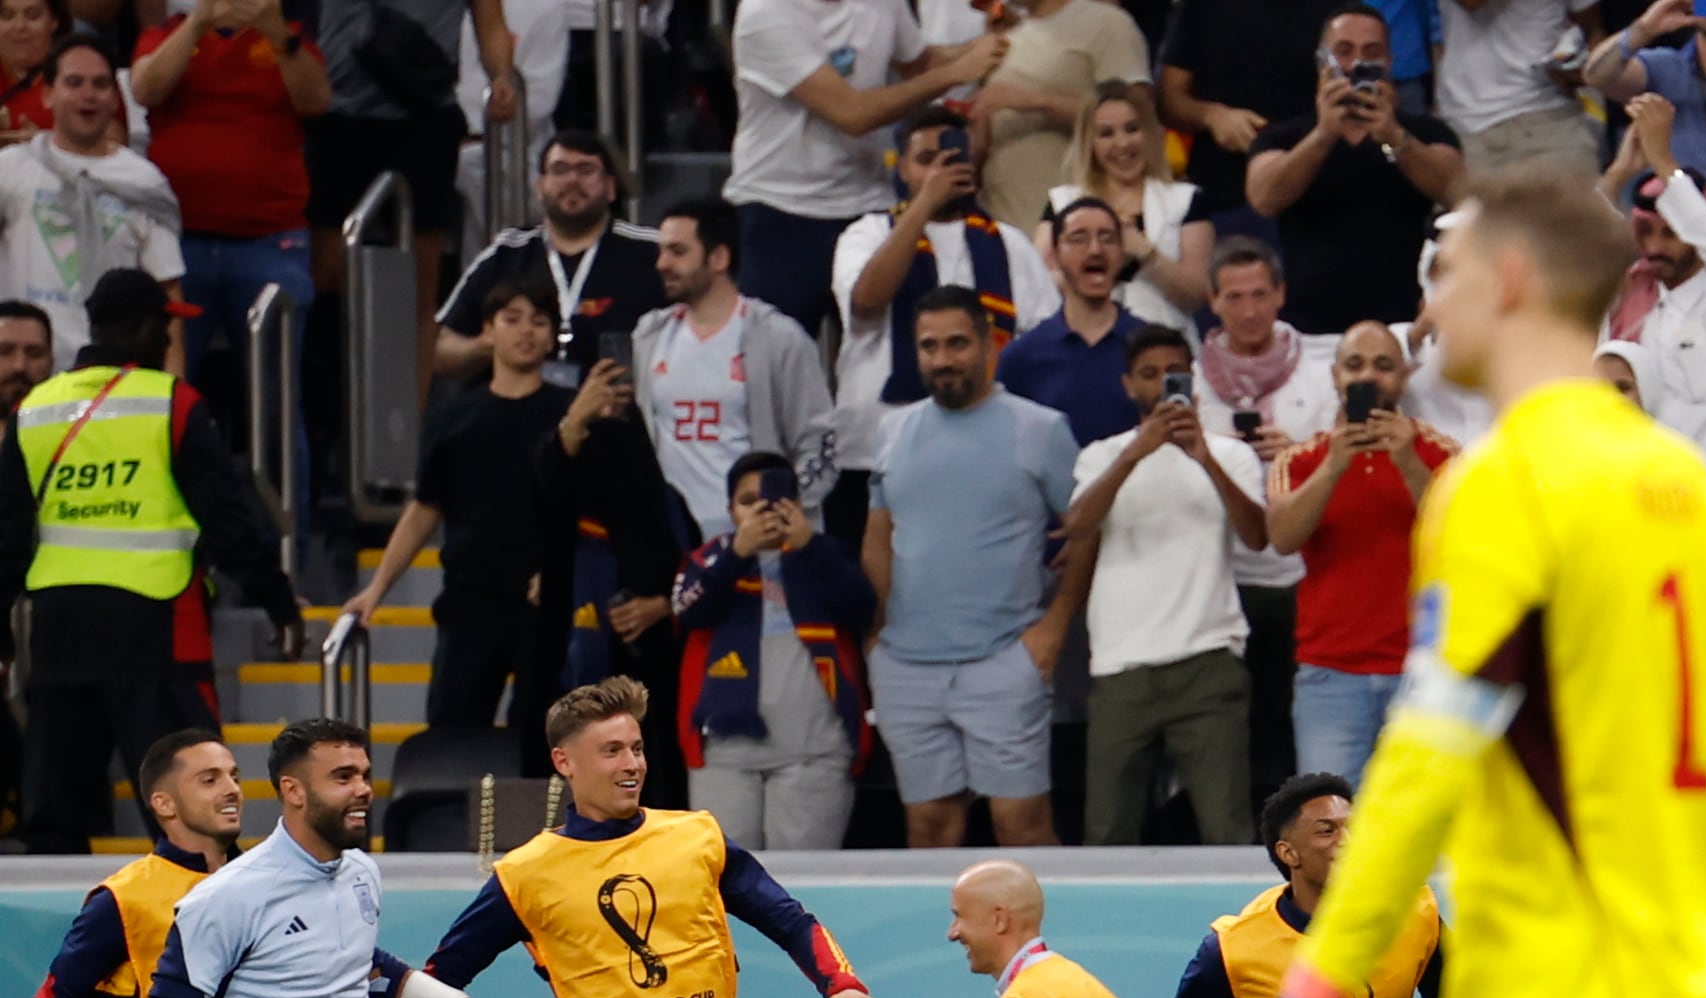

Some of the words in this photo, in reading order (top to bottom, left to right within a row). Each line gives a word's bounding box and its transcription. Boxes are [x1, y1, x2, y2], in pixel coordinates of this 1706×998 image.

[674, 400, 721, 441] 22
[56, 460, 141, 490] 2917
[57, 500, 141, 520] Security
